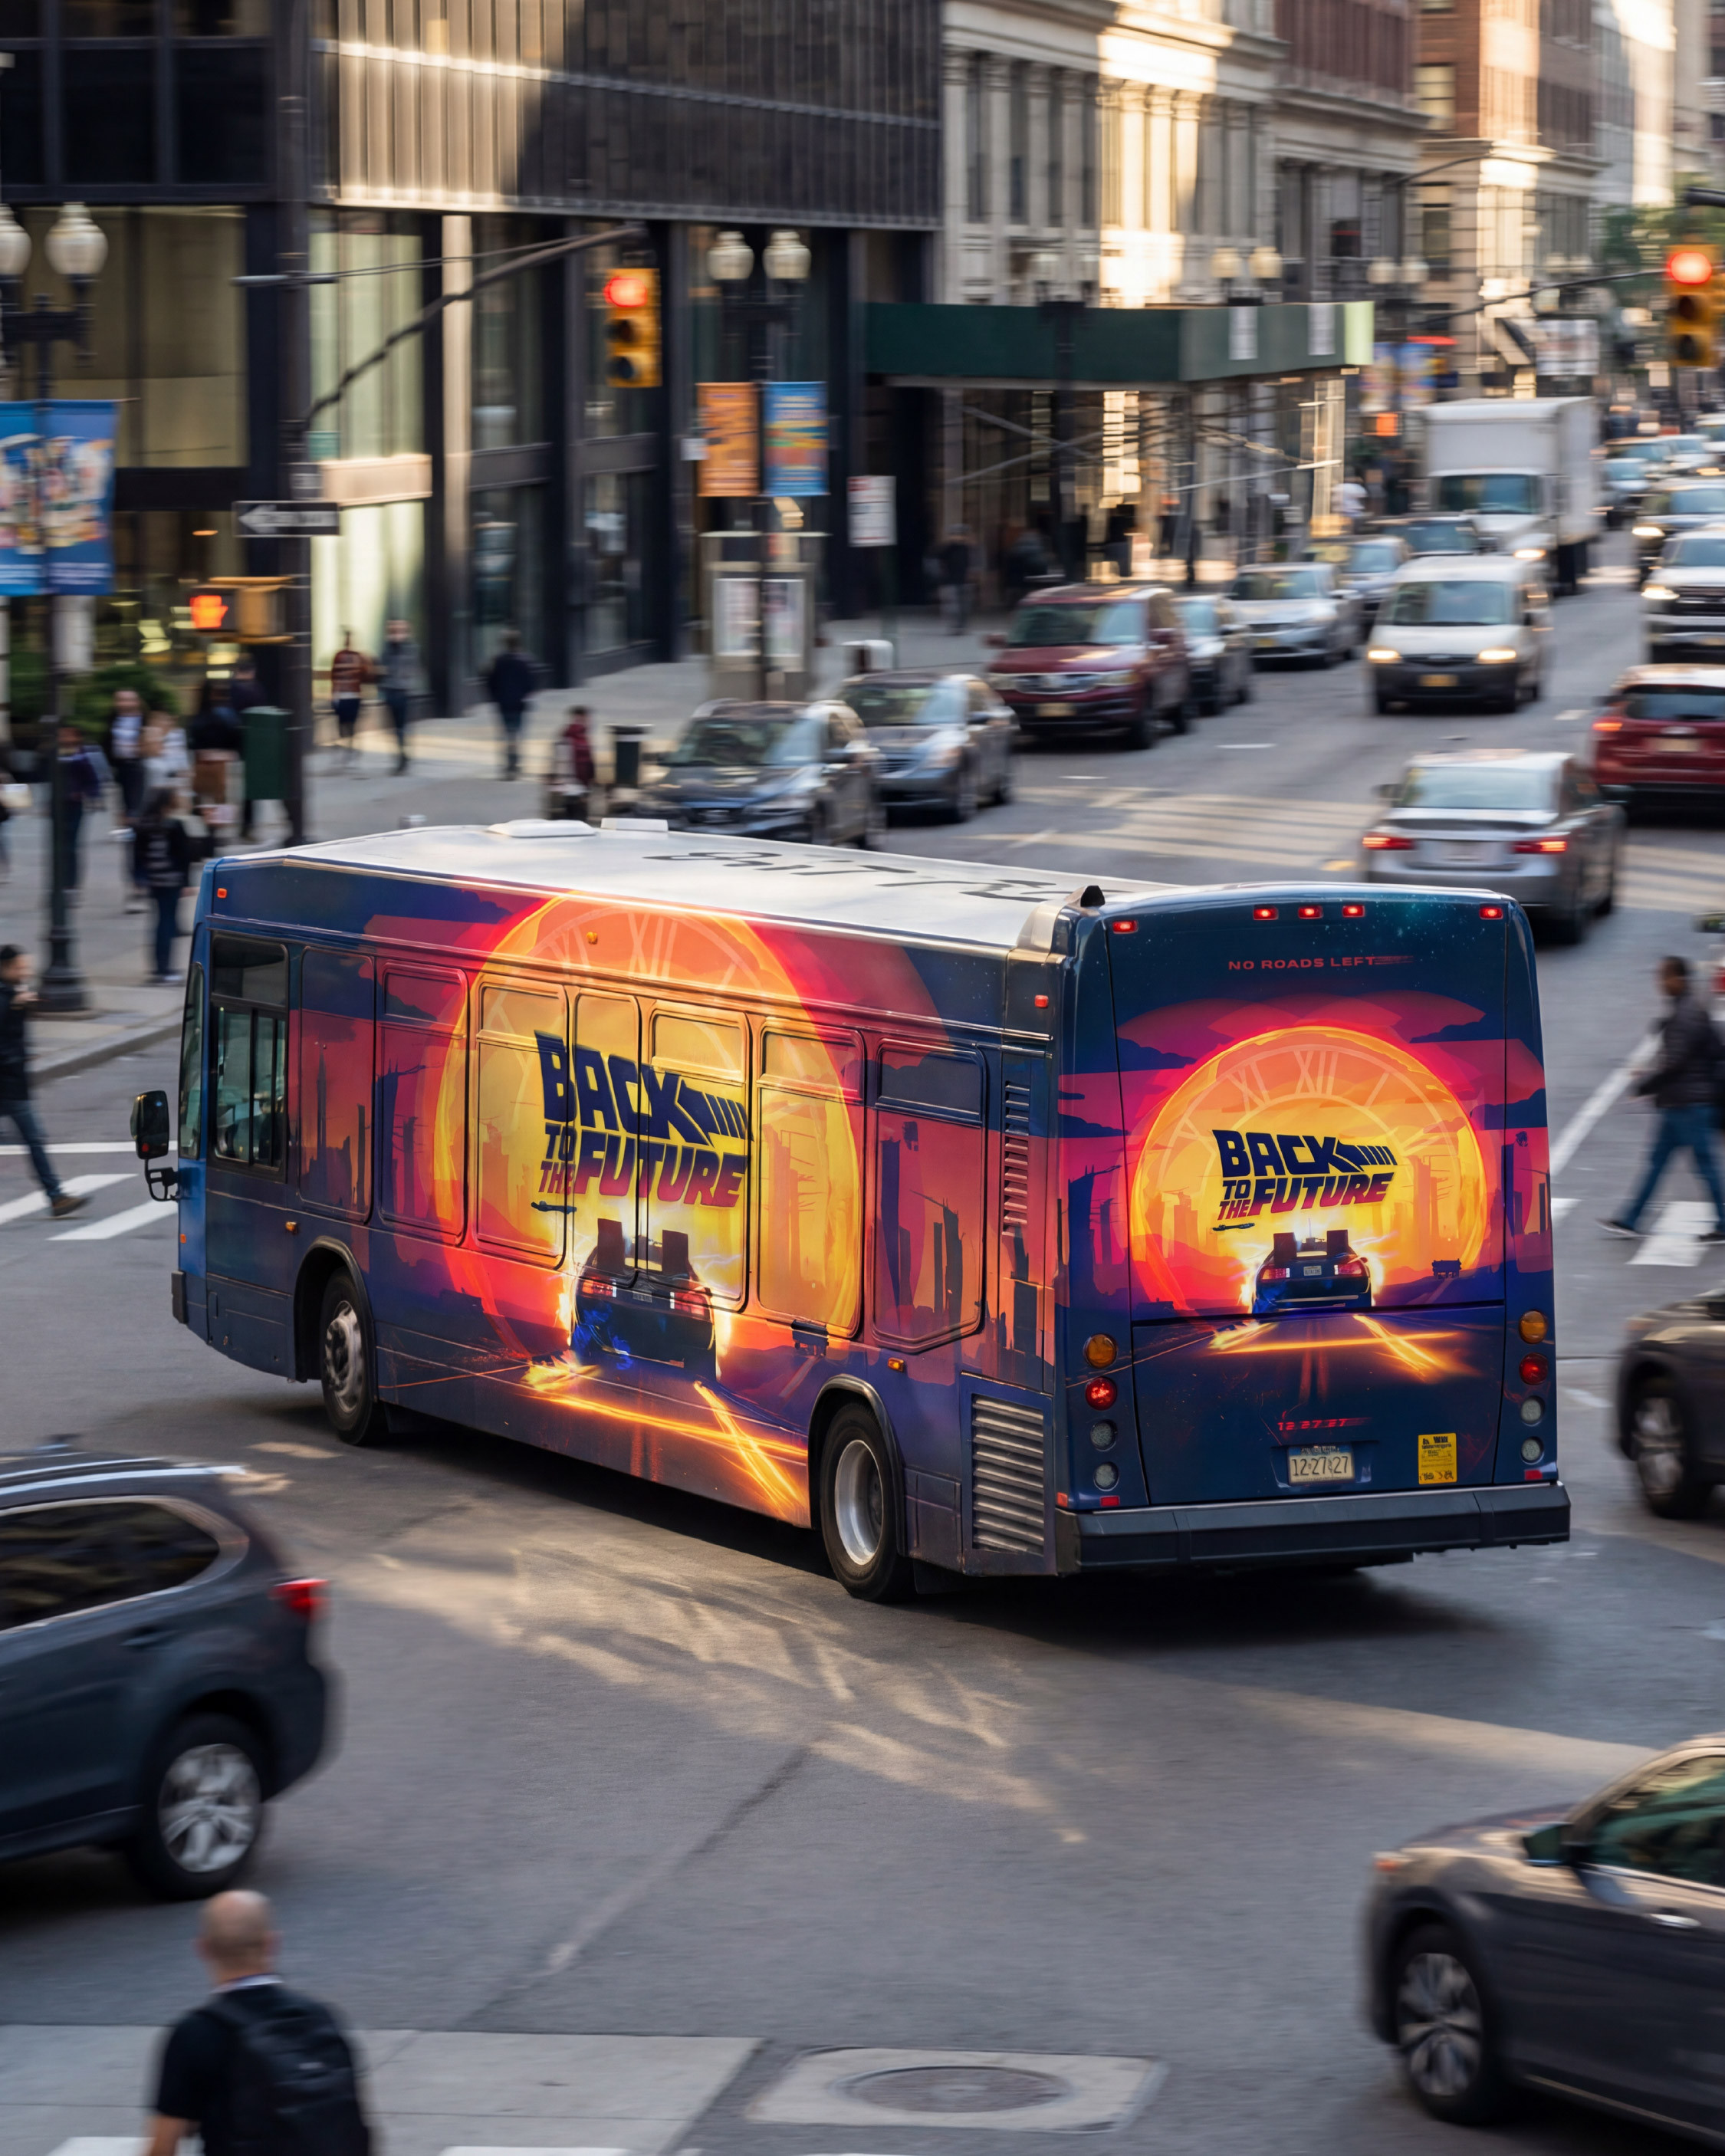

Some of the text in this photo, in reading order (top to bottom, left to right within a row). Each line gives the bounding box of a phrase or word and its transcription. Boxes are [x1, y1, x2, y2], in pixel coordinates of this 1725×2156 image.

[1228, 956, 1375, 970] NO ROADS LEFT
[534, 1030, 716, 1147] BACK
[545, 1122, 577, 1162] TO
[1212, 1129, 1365, 1178] BACK
[538, 1160, 575, 1196] THE
[575, 1129, 749, 1208] FUTURE
[1223, 1179, 1251, 1200] TO
[1247, 1172, 1395, 1217] FUTURE
[1217, 1199, 1251, 1221] THE
[1278, 1421, 1295, 1431] 12
